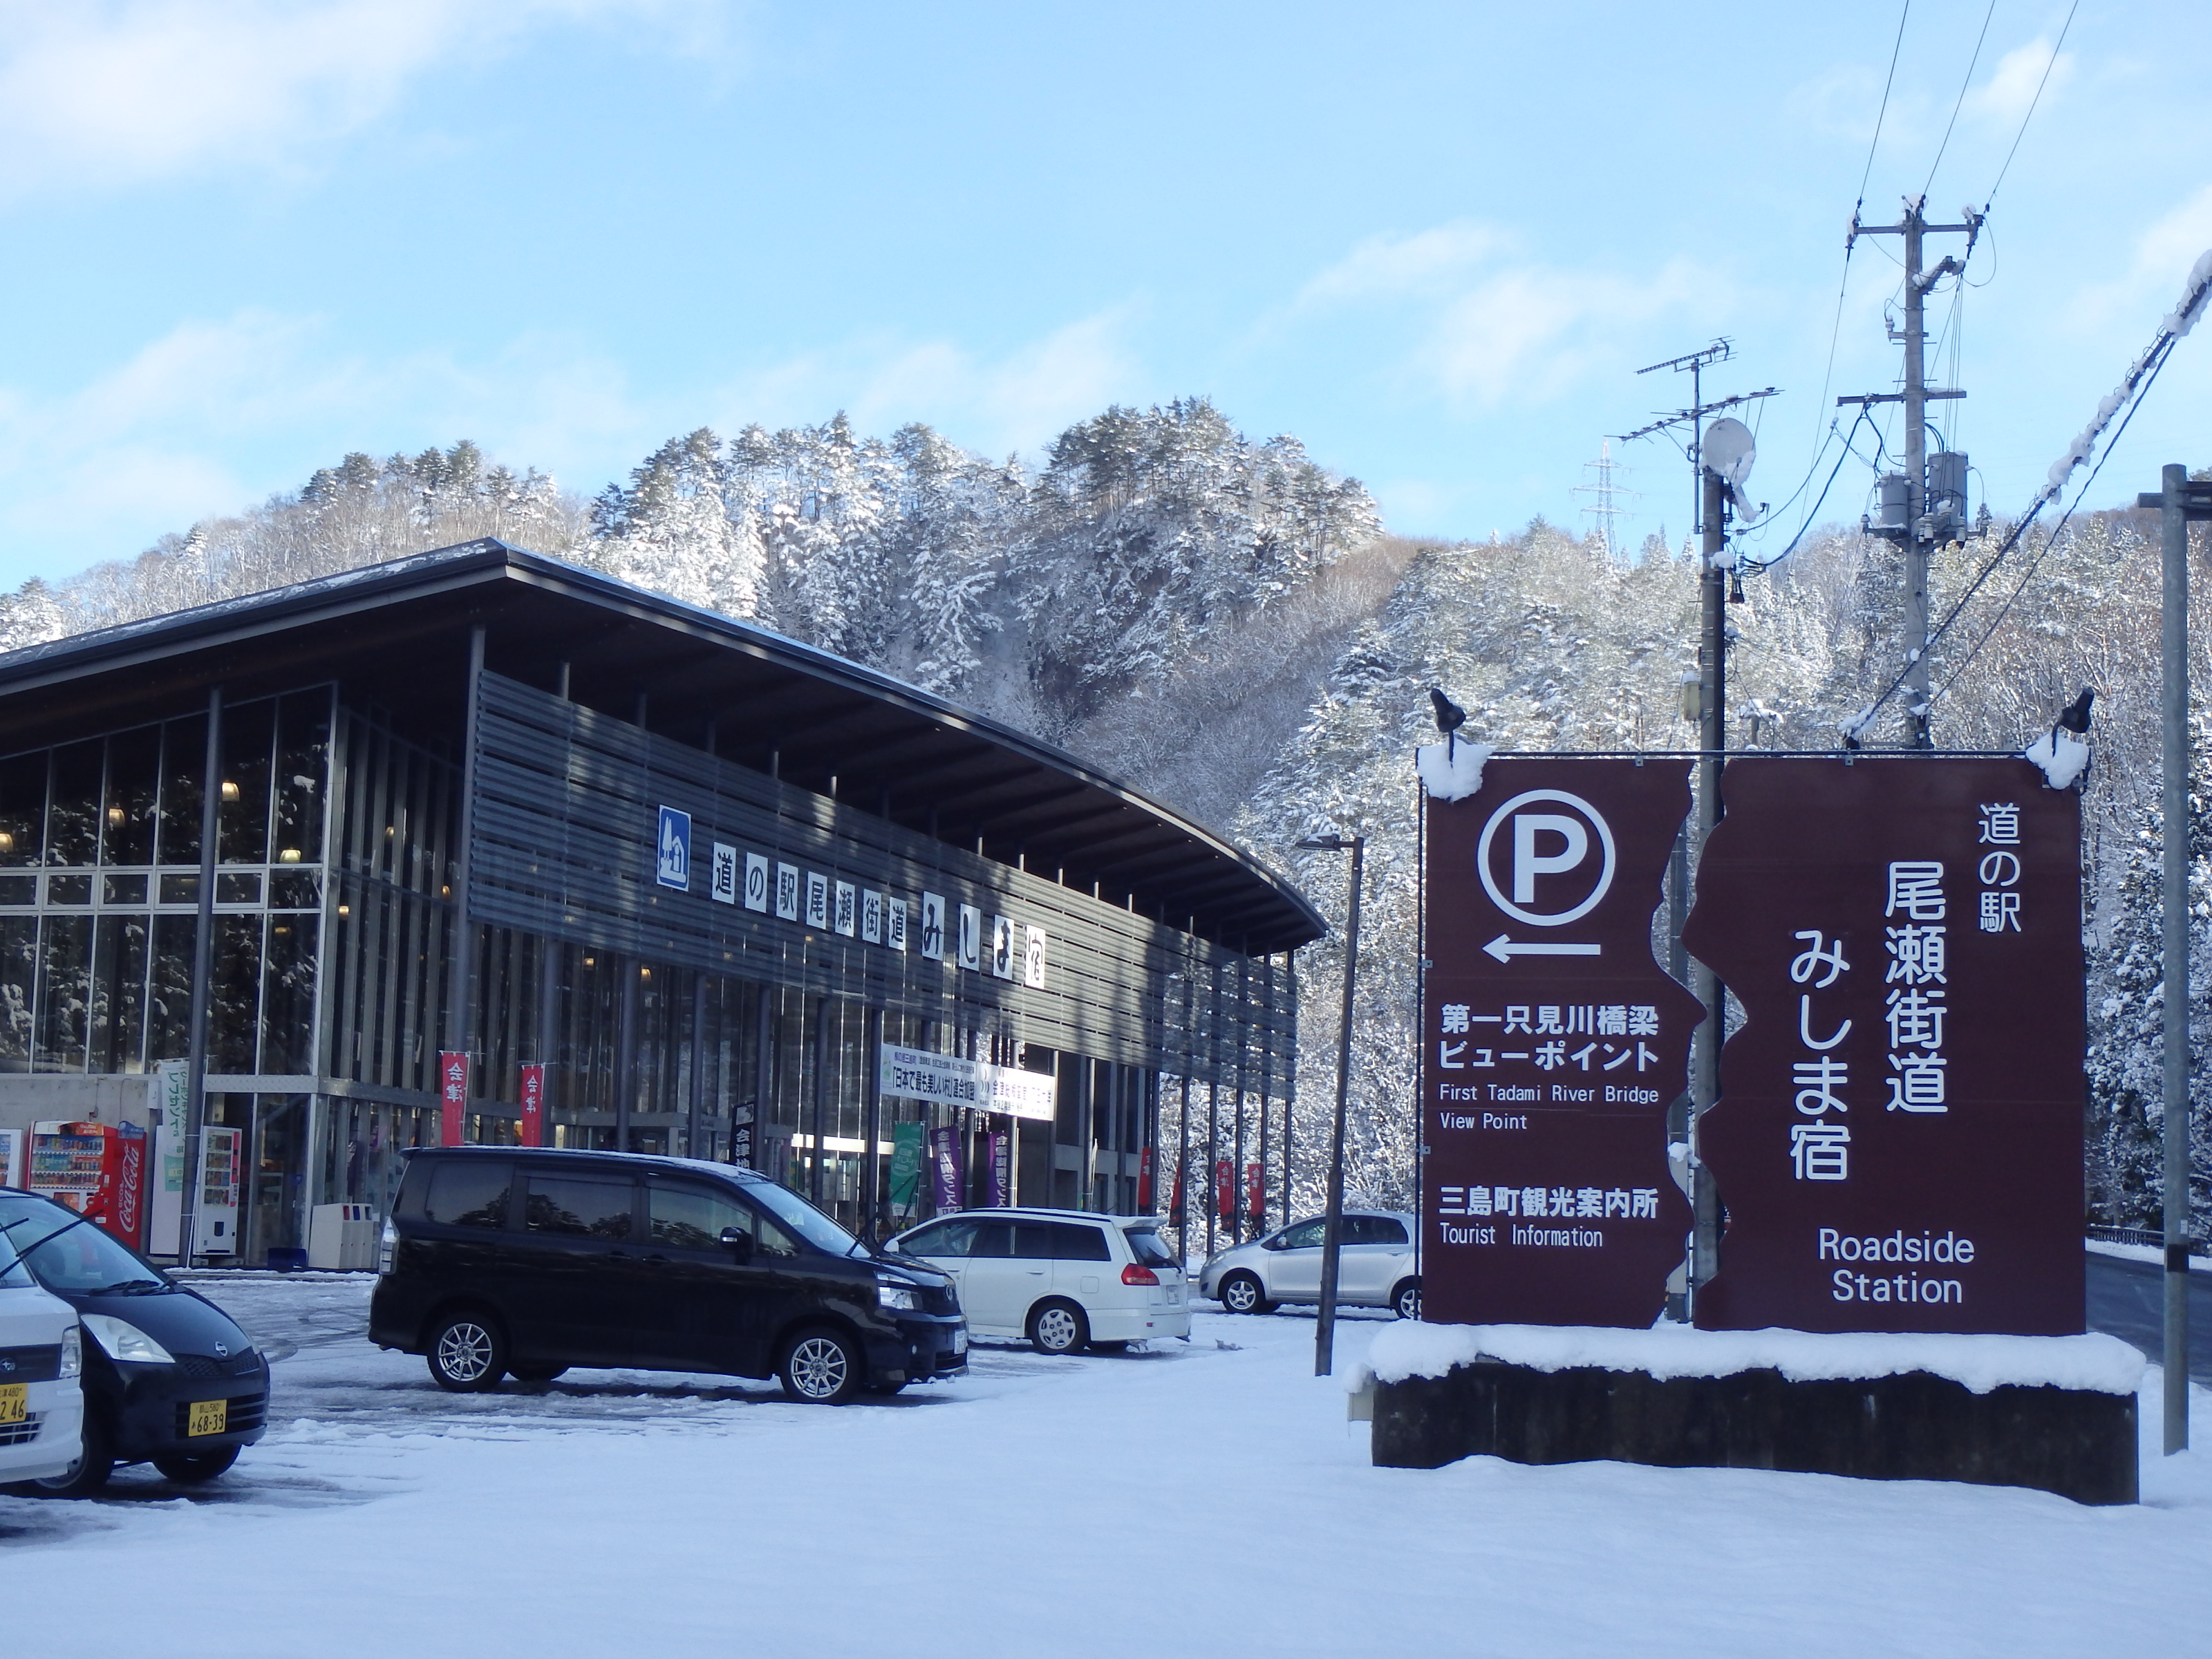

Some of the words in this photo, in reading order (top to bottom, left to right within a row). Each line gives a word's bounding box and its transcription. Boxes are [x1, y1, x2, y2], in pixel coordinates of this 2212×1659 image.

[1514, 814, 1588, 903] P
[1978, 802, 2022, 932] 道の駅
[715, 851, 905, 943] 道の駅尾瀬街道
[1884, 861, 1949, 1114] 尾瀬街道
[1441, 1004, 1659, 1036] 第一只見川橋梁
[1439, 1040, 1658, 1072] ビューポイント
[1789, 929, 1852, 1181] みしま宿
[1439, 1083, 1477, 1100] First
[1487, 1084, 1541, 1101] Tadami
[1552, 1085, 1595, 1102] River
[1604, 1085, 1659, 1105] Bridge
[1440, 1112, 1474, 1129] View
[1483, 1112, 1527, 1130] Point
[119, 1141, 140, 1232] Coca-Cola
[1439, 1185, 1658, 1219] 三島町観光案内所
[1439, 1222, 1495, 1245] Tourist
[1512, 1224, 1602, 1247] Information
[1819, 1228, 1975, 1264] Roadside
[1832, 1269, 1962, 1303] Station
